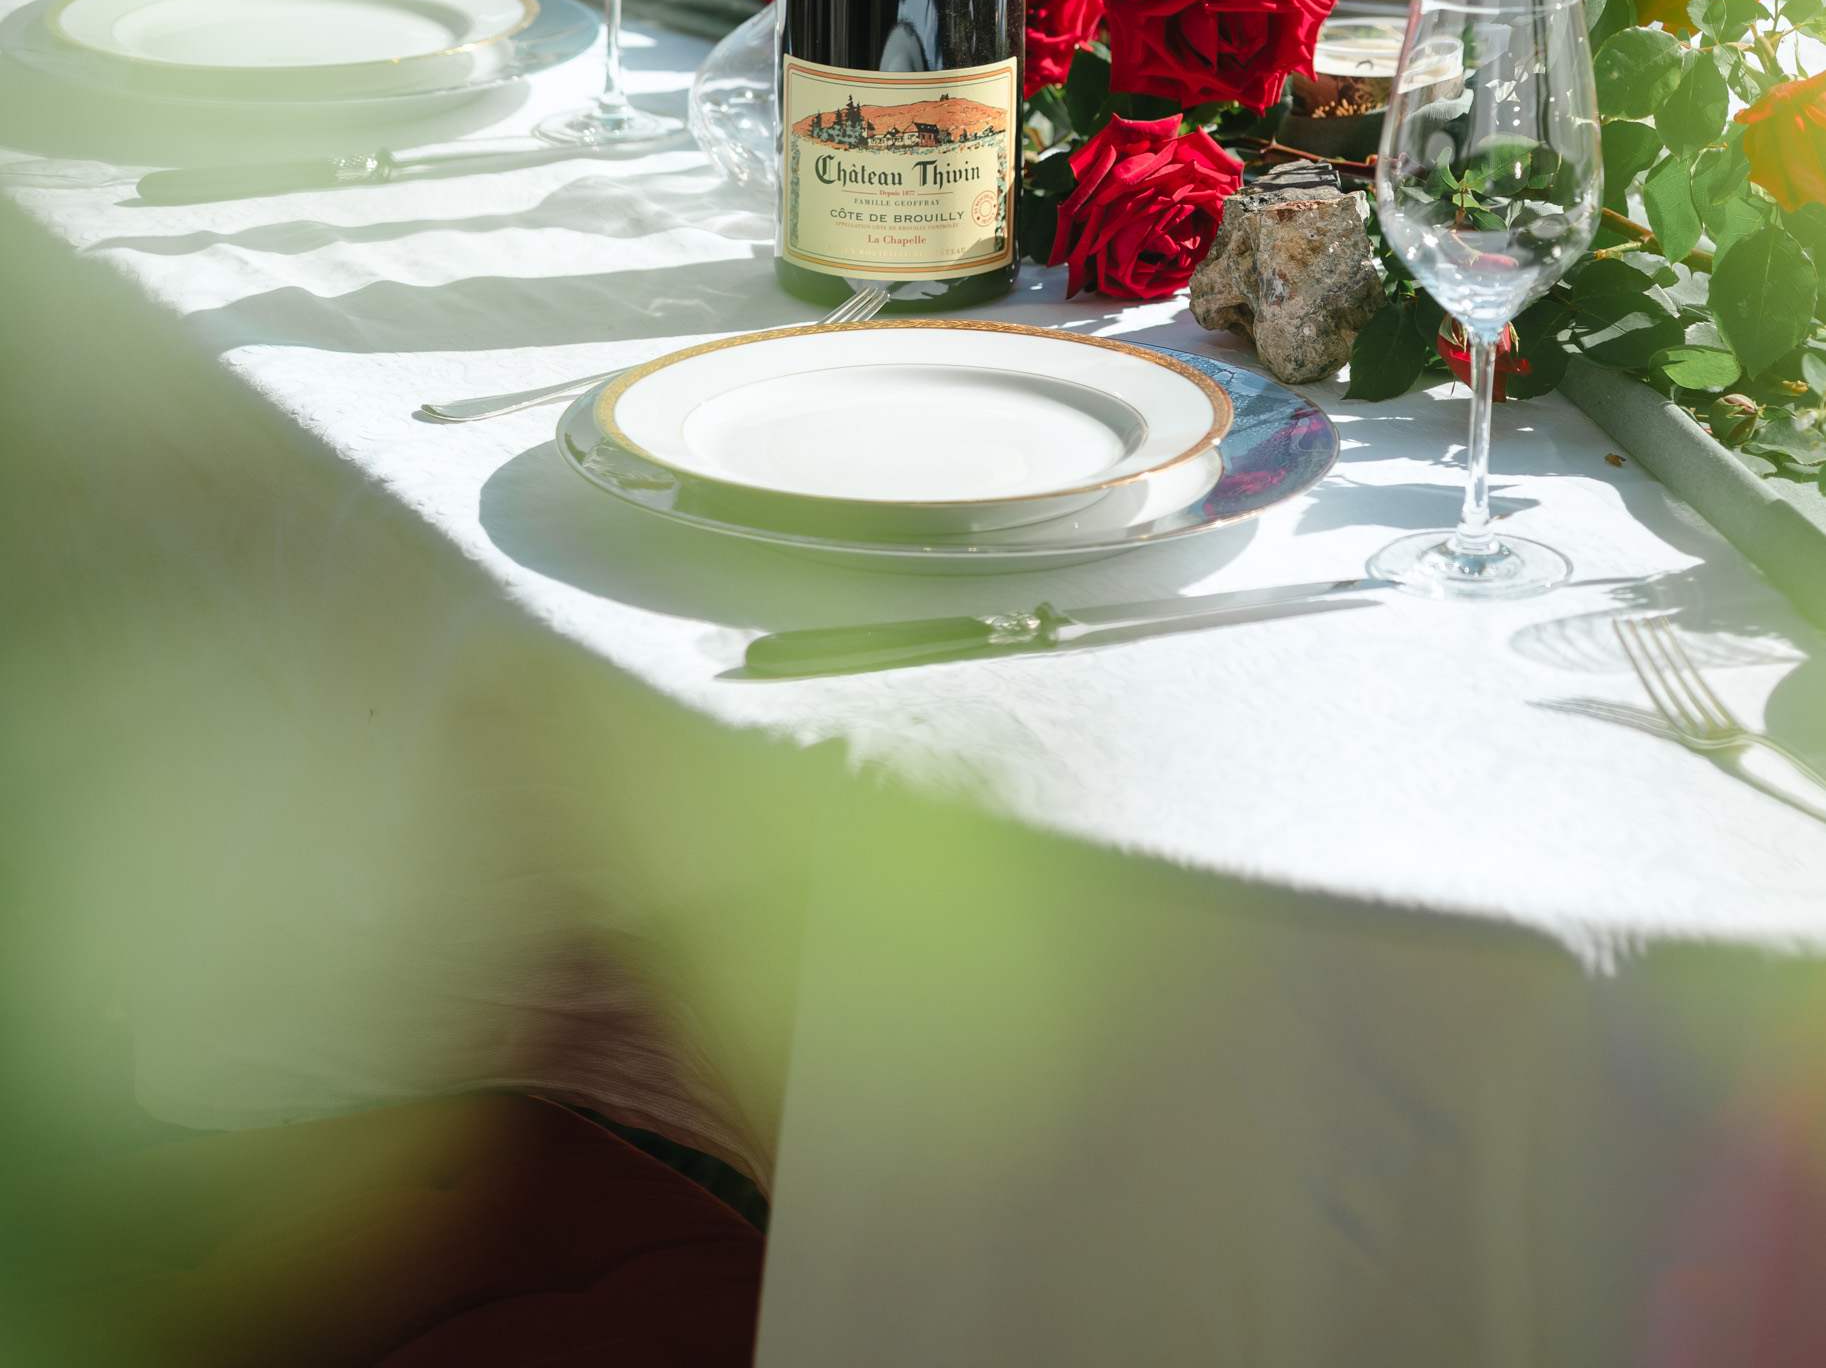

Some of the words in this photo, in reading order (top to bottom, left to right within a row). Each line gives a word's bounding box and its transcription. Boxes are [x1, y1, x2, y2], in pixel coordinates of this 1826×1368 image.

[815, 154, 903, 187] Château
[911, 159, 980, 190] Thivin
[879, 189, 900, 197] Depuis
[854, 197, 891, 207] FAMILLE
[894, 199, 940, 207] GEOFFRAY
[829, 207, 864, 222] CÔTE
[869, 213, 888, 223] DE
[893, 210, 965, 223] BROUILLY
[834, 221, 871, 230] APPELLATION
[868, 234, 880, 244] La
[883, 235, 927, 248] Chapelle
